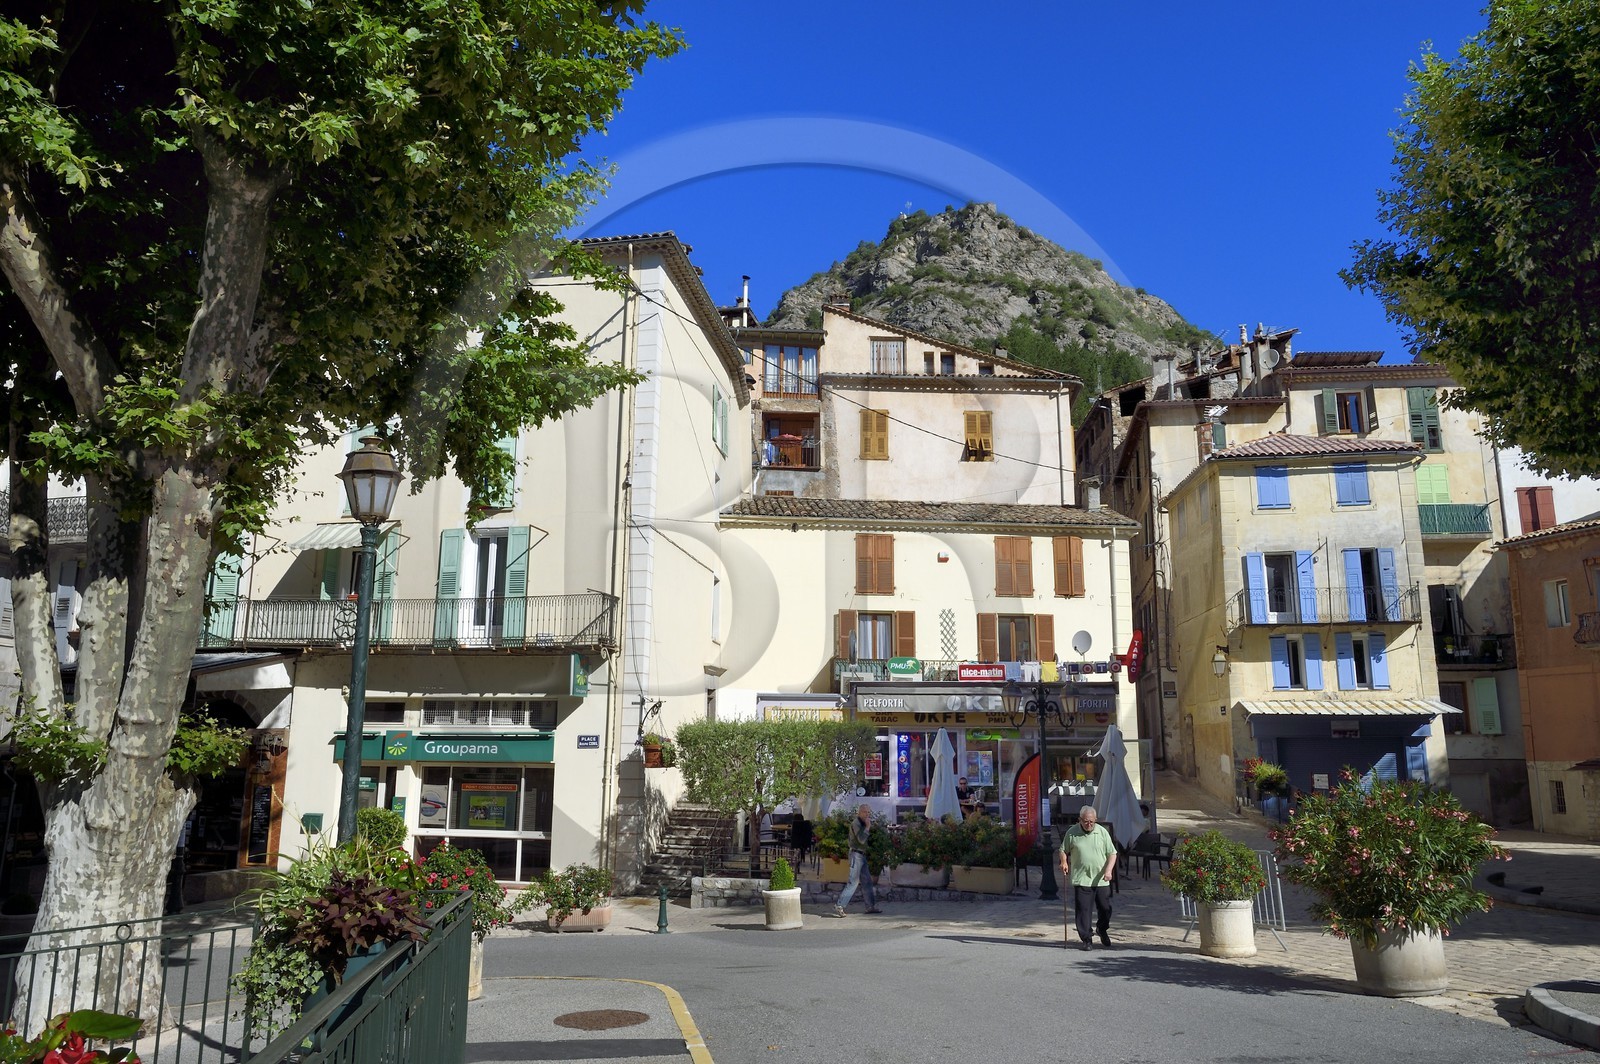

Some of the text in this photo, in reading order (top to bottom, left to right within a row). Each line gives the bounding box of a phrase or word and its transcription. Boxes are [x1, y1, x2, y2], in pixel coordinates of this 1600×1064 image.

[1130, 640, 1140, 673] TABAC
[960, 667, 1003, 678] nice-matin
[1069, 661, 1121, 674] LOTO
[864, 698, 904, 708] PELFORTH
[424, 741, 498, 756] Groupama
[1018, 784, 1028, 825] PELFORTH
